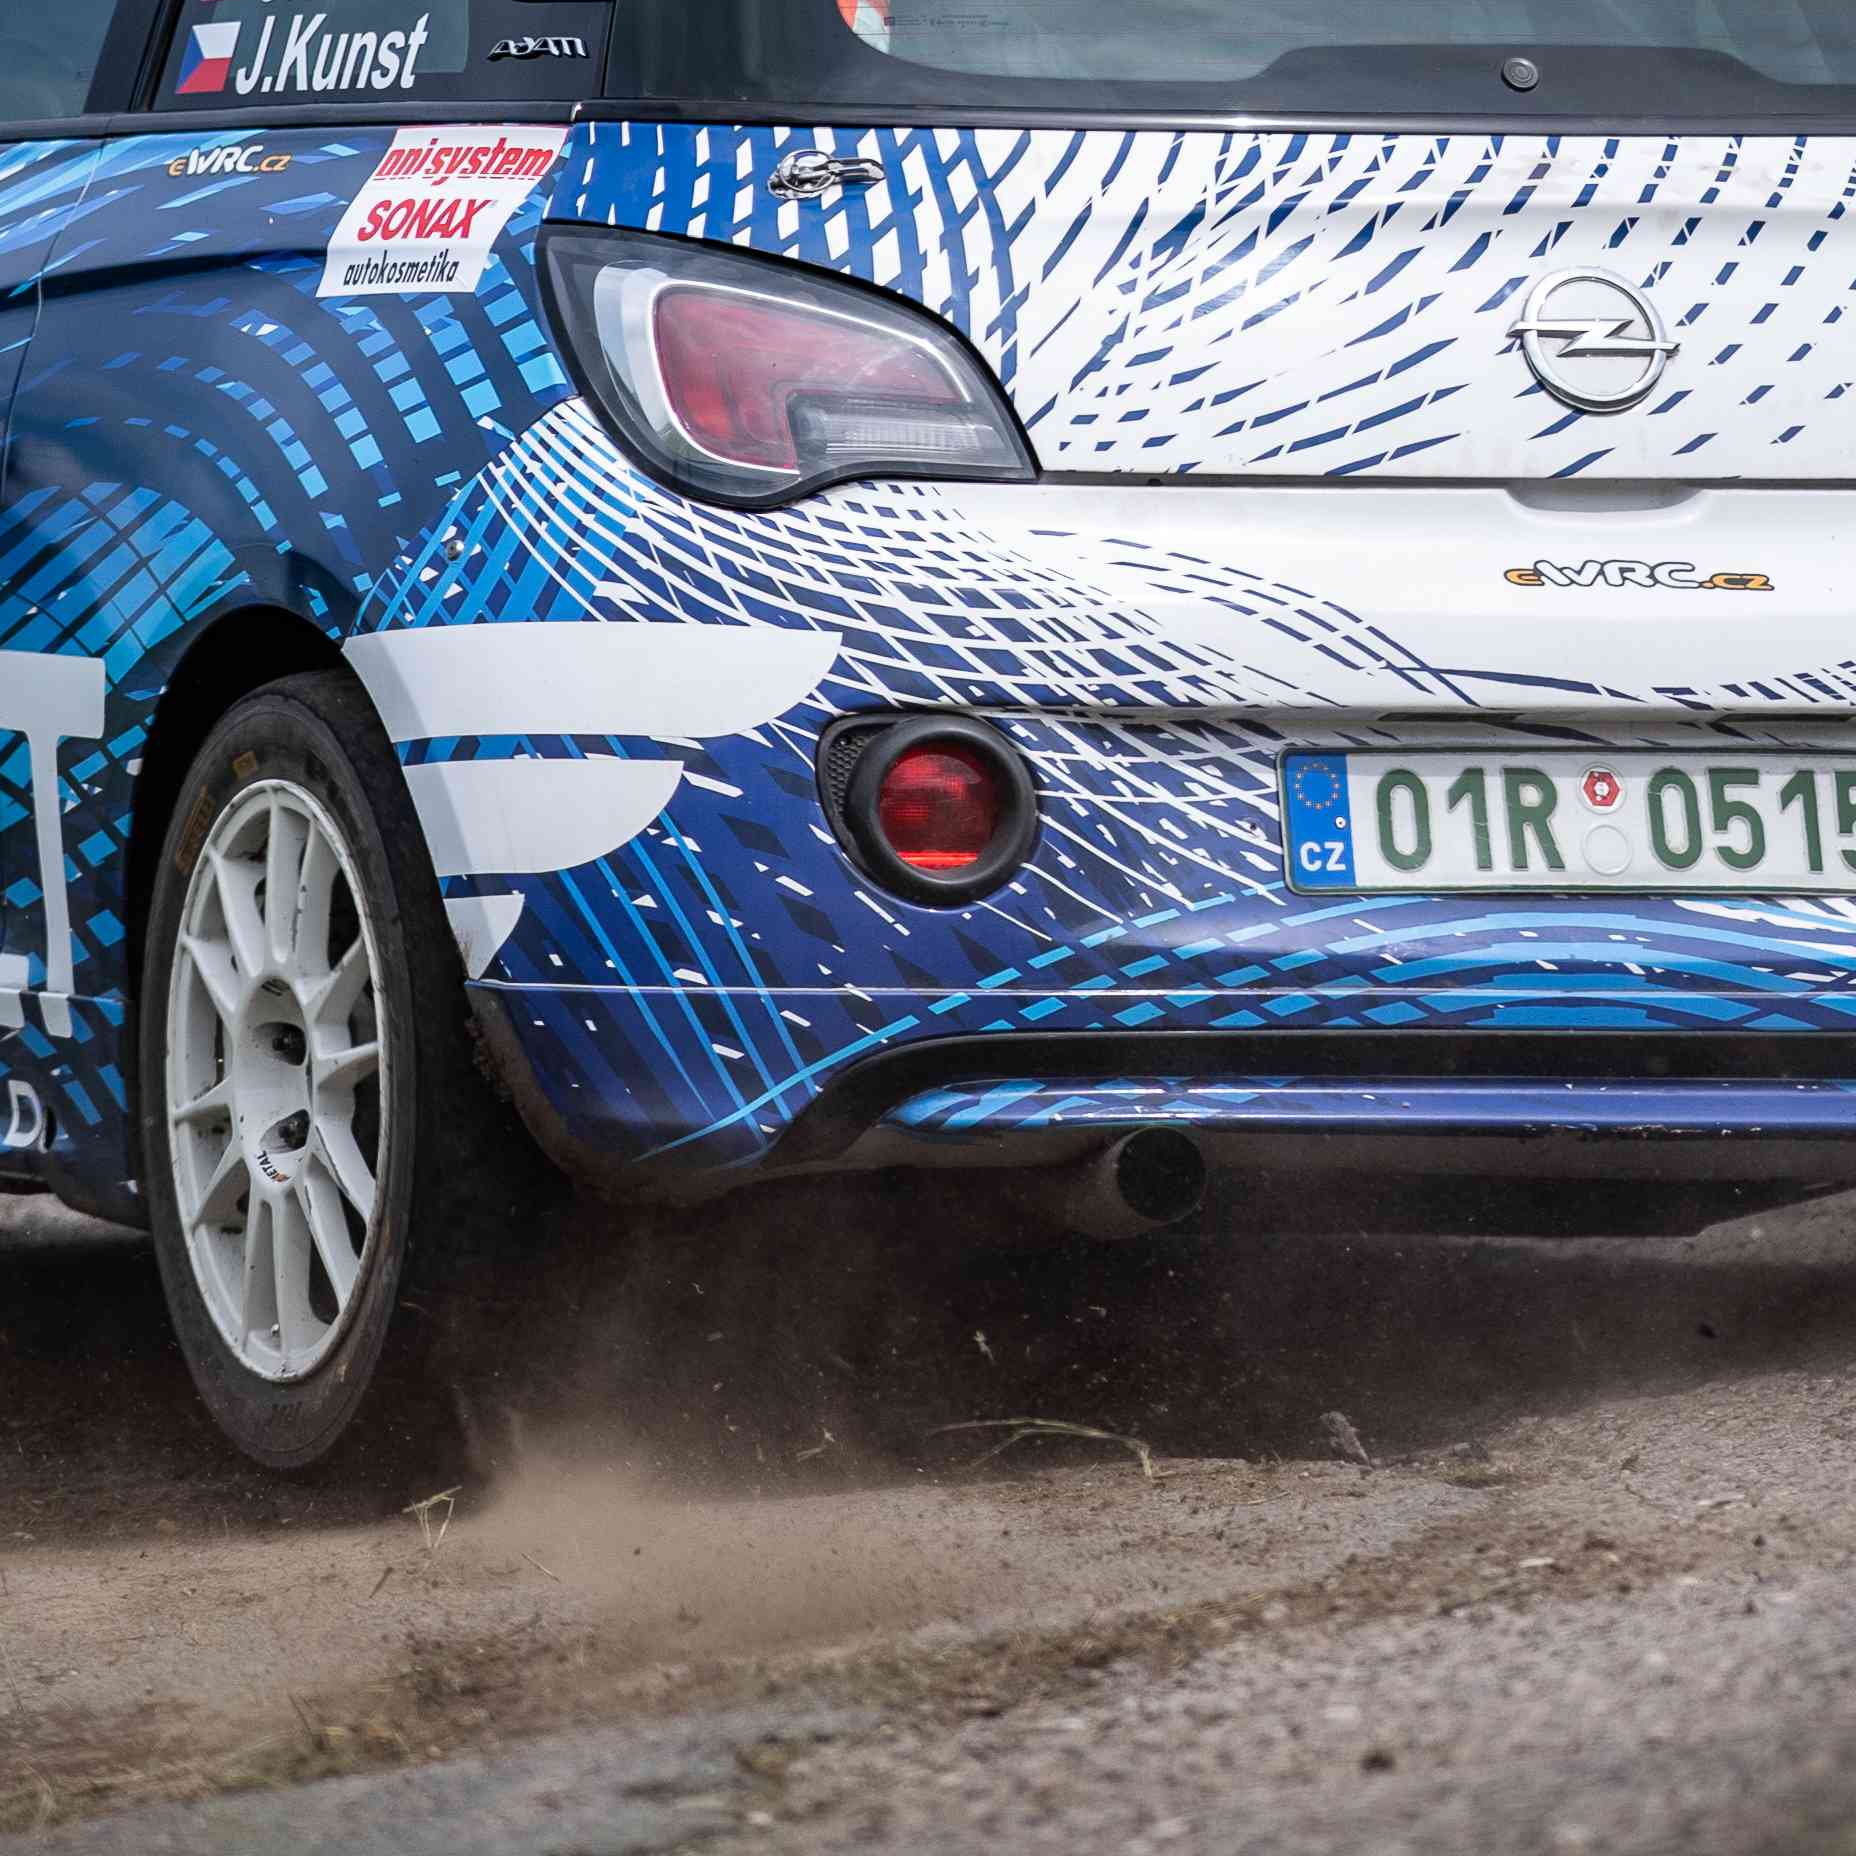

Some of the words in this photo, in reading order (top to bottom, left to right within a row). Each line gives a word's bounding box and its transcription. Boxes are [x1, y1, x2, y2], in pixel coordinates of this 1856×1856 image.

[235, 12, 429, 95] J.Kunst
[166, 142, 293, 178] eWRC.cz
[357, 198, 494, 242] SONAX
[343, 248, 460, 286] autokosmetika
[1503, 559, 1775, 591] eWRC.cz
[1300, 839, 1347, 873] CZ
[1375, 766, 1567, 872] 01R
